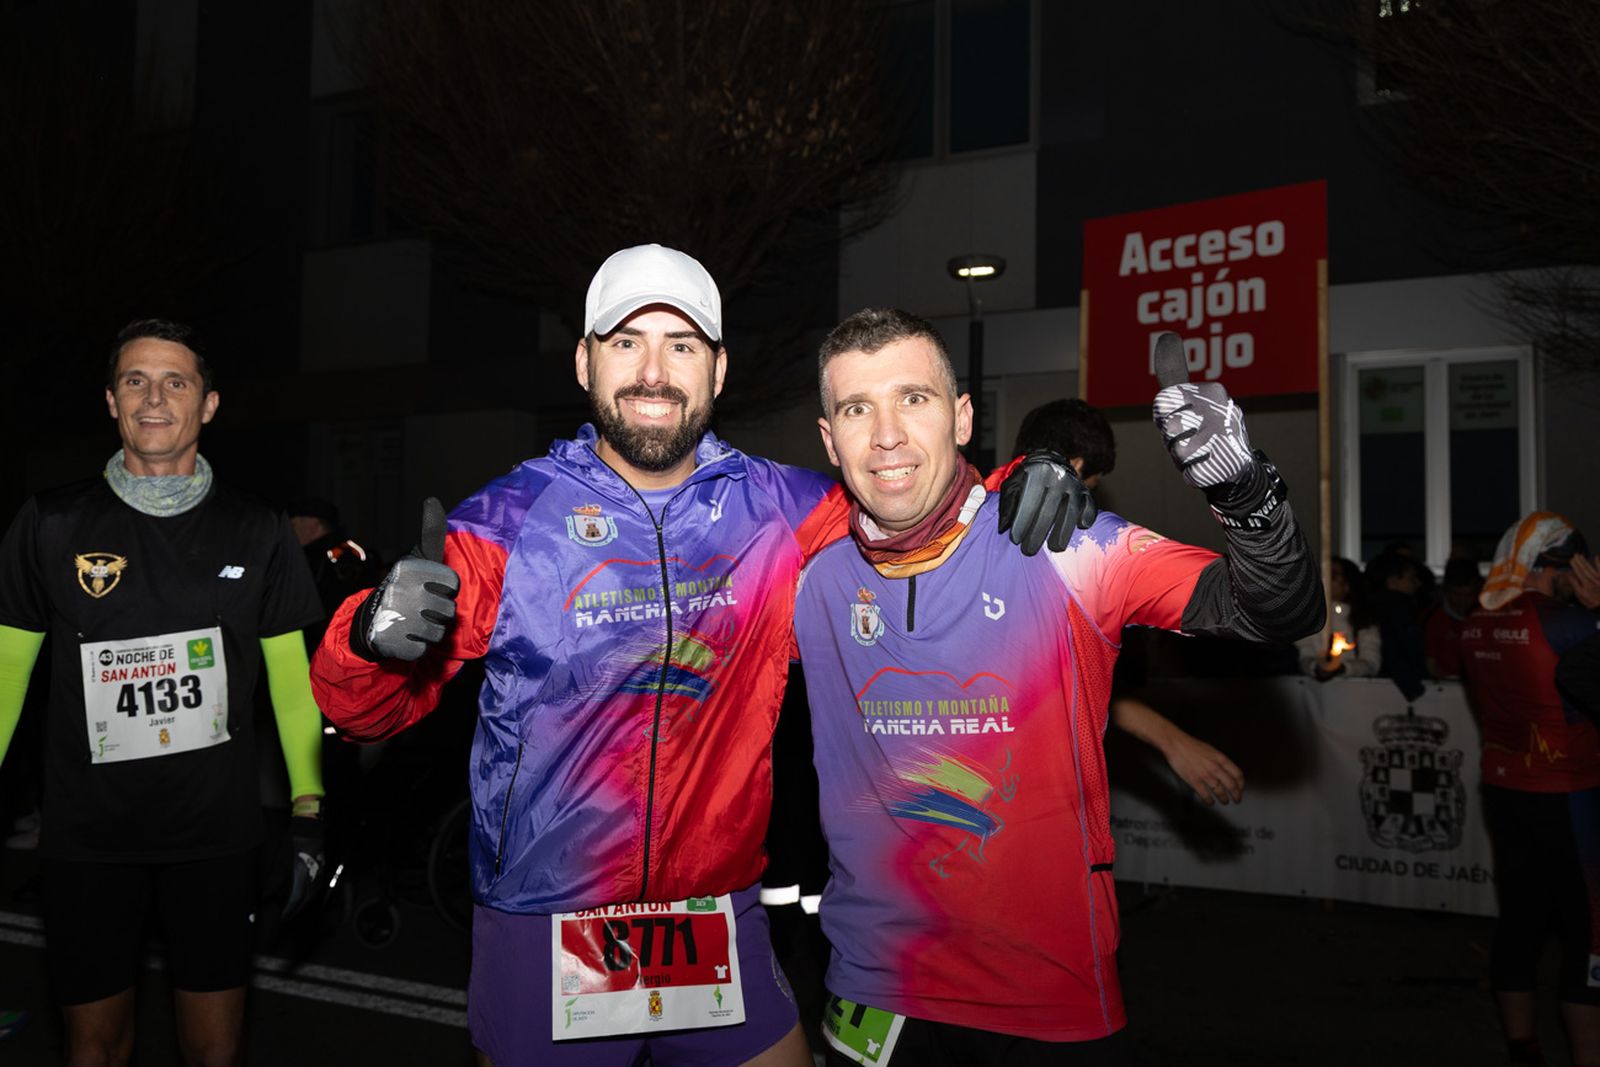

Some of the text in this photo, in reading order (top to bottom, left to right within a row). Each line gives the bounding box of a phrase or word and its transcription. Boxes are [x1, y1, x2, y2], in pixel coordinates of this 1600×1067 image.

[1118, 220, 1286, 277] Acceso
[1137, 268, 1266, 330] cajón
[574, 587, 656, 609] ATLETISMO
[575, 601, 683, 628] MANCHA
[116, 651, 155, 665] NOCHE
[160, 648, 174, 660] DE
[101, 668, 128, 683] SAN
[131, 661, 176, 680] ANTÓN
[116, 674, 203, 717] 4133
[926, 700, 935, 716] Y
[938, 694, 1010, 716] MONTAÑA
[149, 716, 175, 727] Javier
[950, 716, 1016, 734] REAL
[1335, 855, 1495, 884] CIUDAD DE JAÉN
[602, 917, 697, 971] 8771
